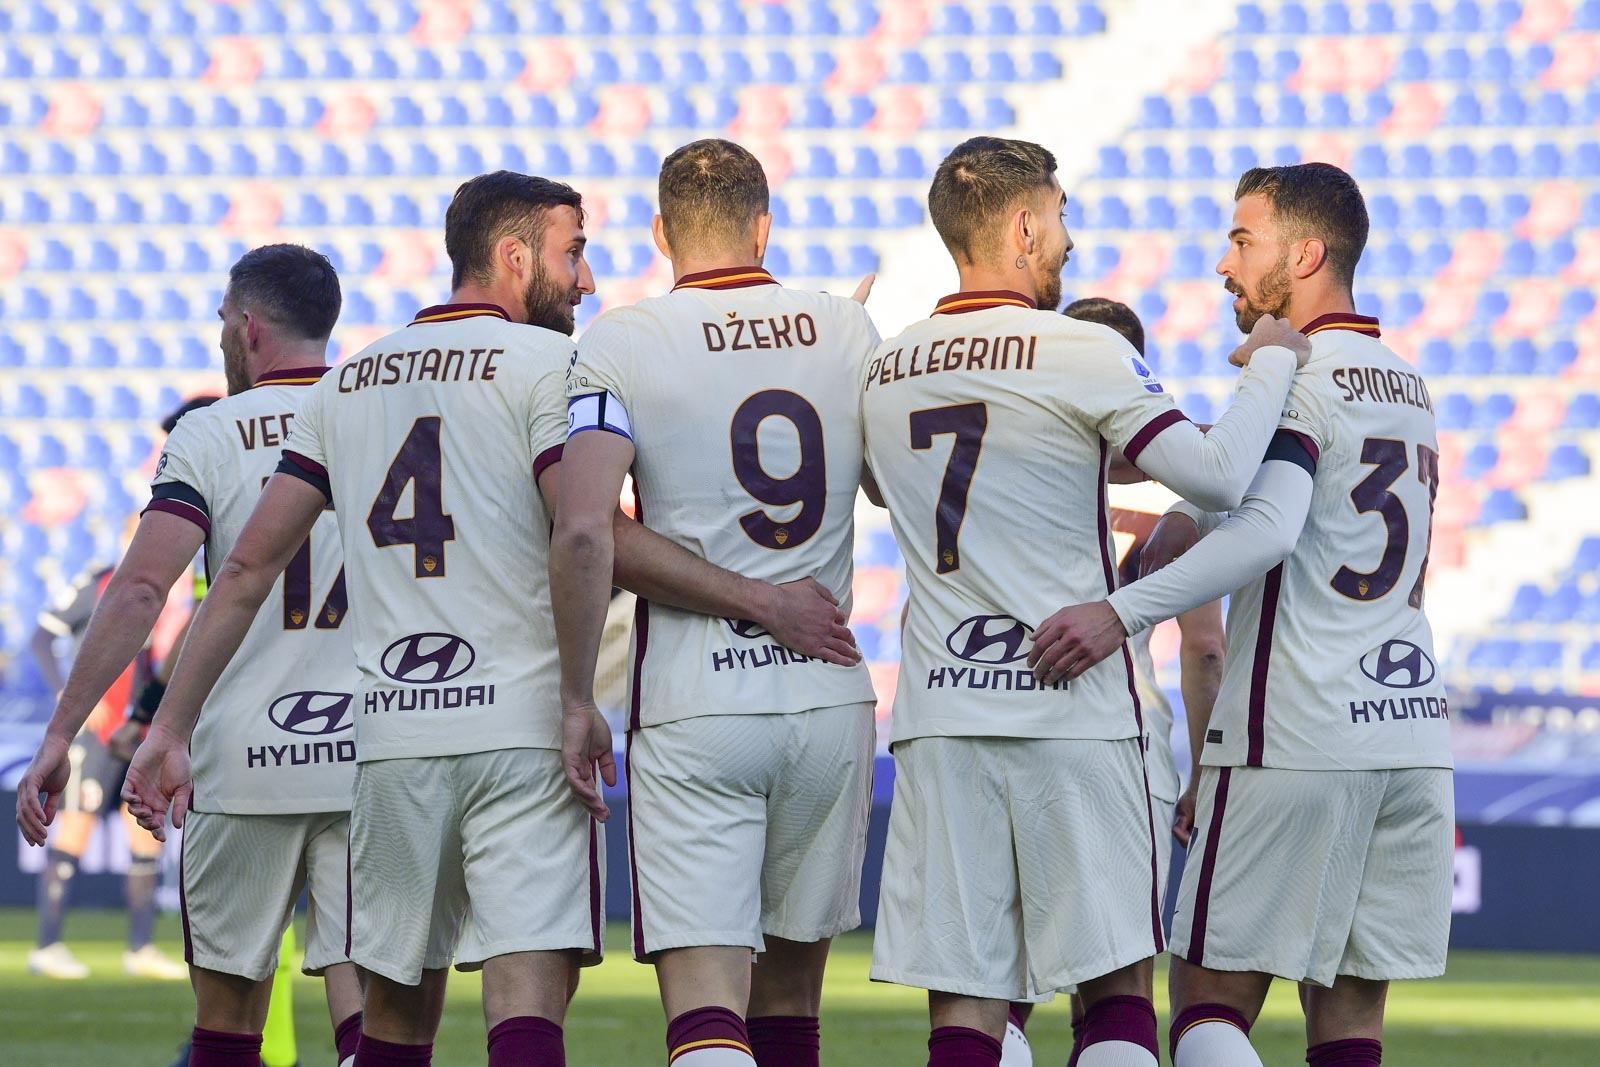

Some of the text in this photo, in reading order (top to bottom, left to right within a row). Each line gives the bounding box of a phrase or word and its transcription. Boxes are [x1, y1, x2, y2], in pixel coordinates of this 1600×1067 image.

[702, 307, 818, 353] DŽEKO
[338, 348, 505, 394] CRISTANTE
[865, 335, 1037, 392] PELLEGRINI
[1332, 368, 1434, 415] SPINAZZO
[731, 388, 827, 551] 9
[909, 401, 989, 576] 7
[367, 416, 456, 579] 4
[712, 644, 830, 672] HYUND
[364, 684, 495, 715] HYUNDAI
[1349, 697, 1449, 723] HYUNDA
[247, 740, 357, 768] HYUND
